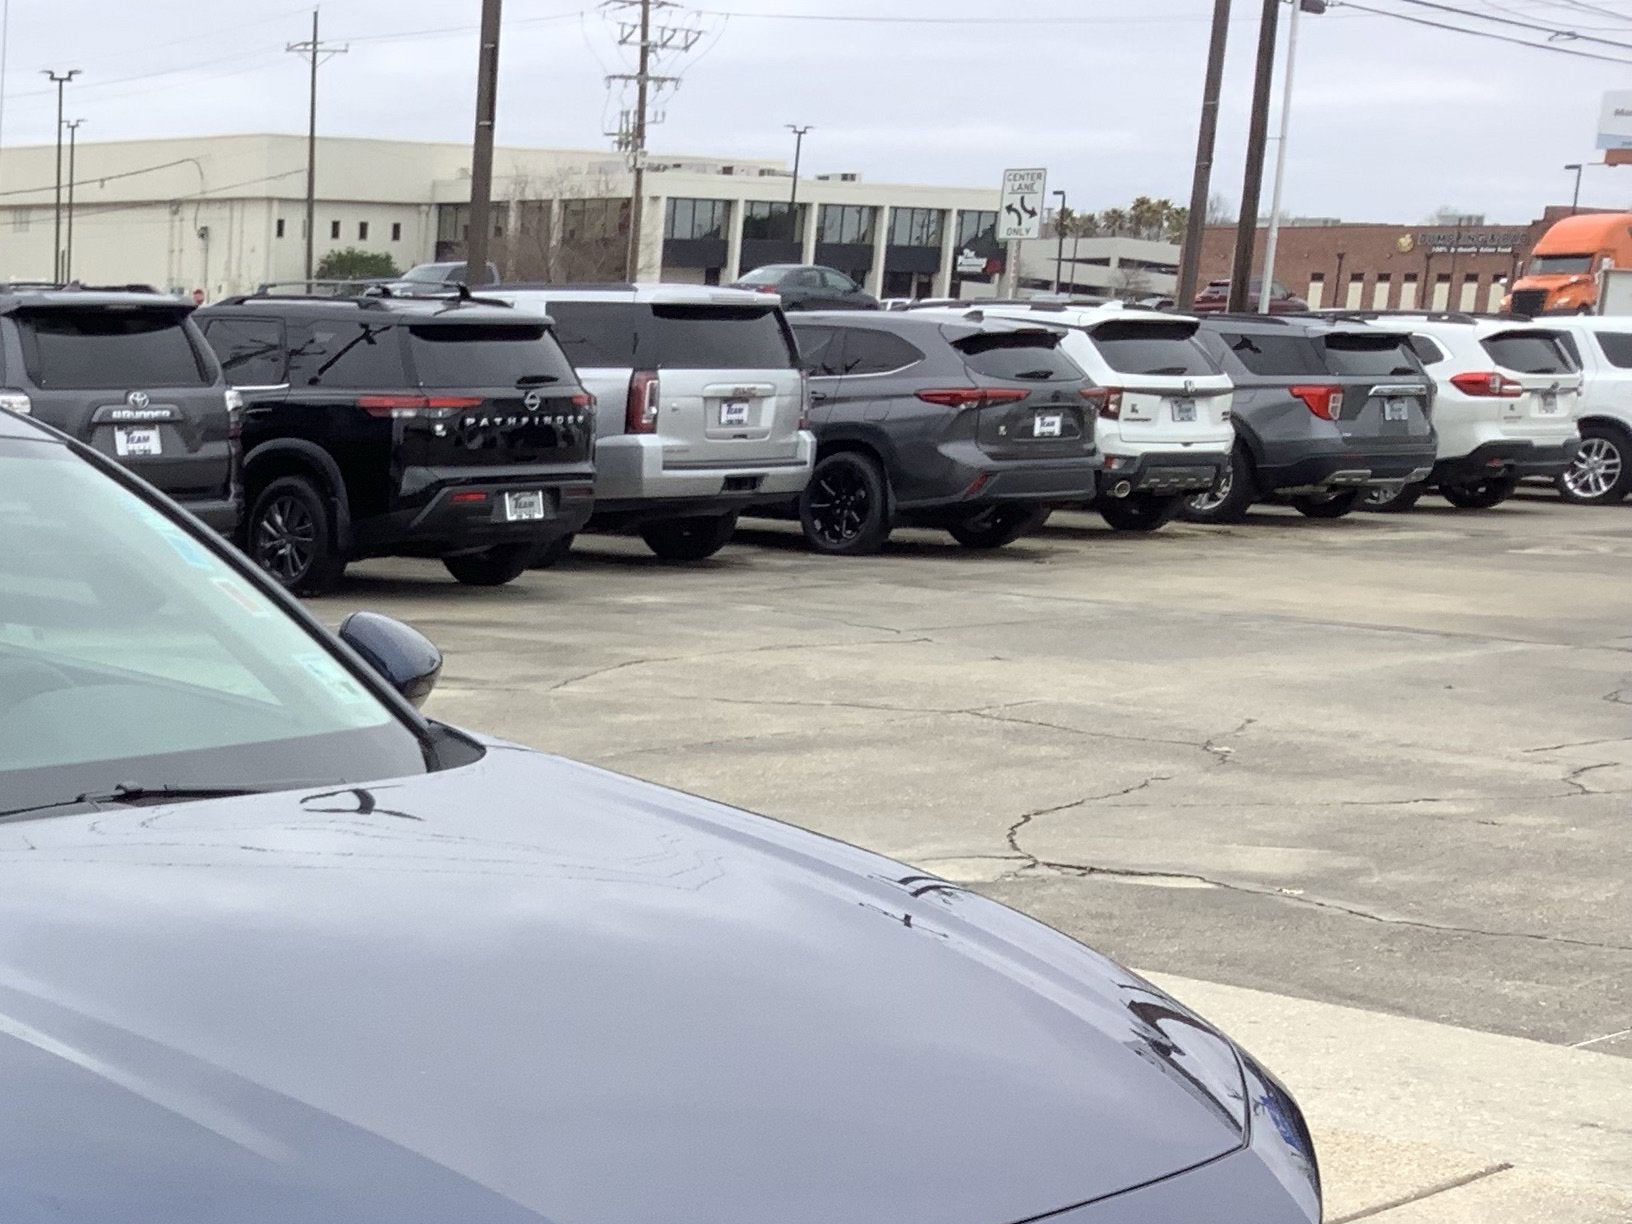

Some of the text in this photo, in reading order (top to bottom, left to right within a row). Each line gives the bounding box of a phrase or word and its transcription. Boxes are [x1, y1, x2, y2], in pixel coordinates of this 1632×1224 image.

[1007, 172, 1042, 182] CENTER
[1011, 182, 1035, 192] LANE
[1006, 227, 1031, 236] ONLY
[465, 415, 584, 427] PATHFINDER
